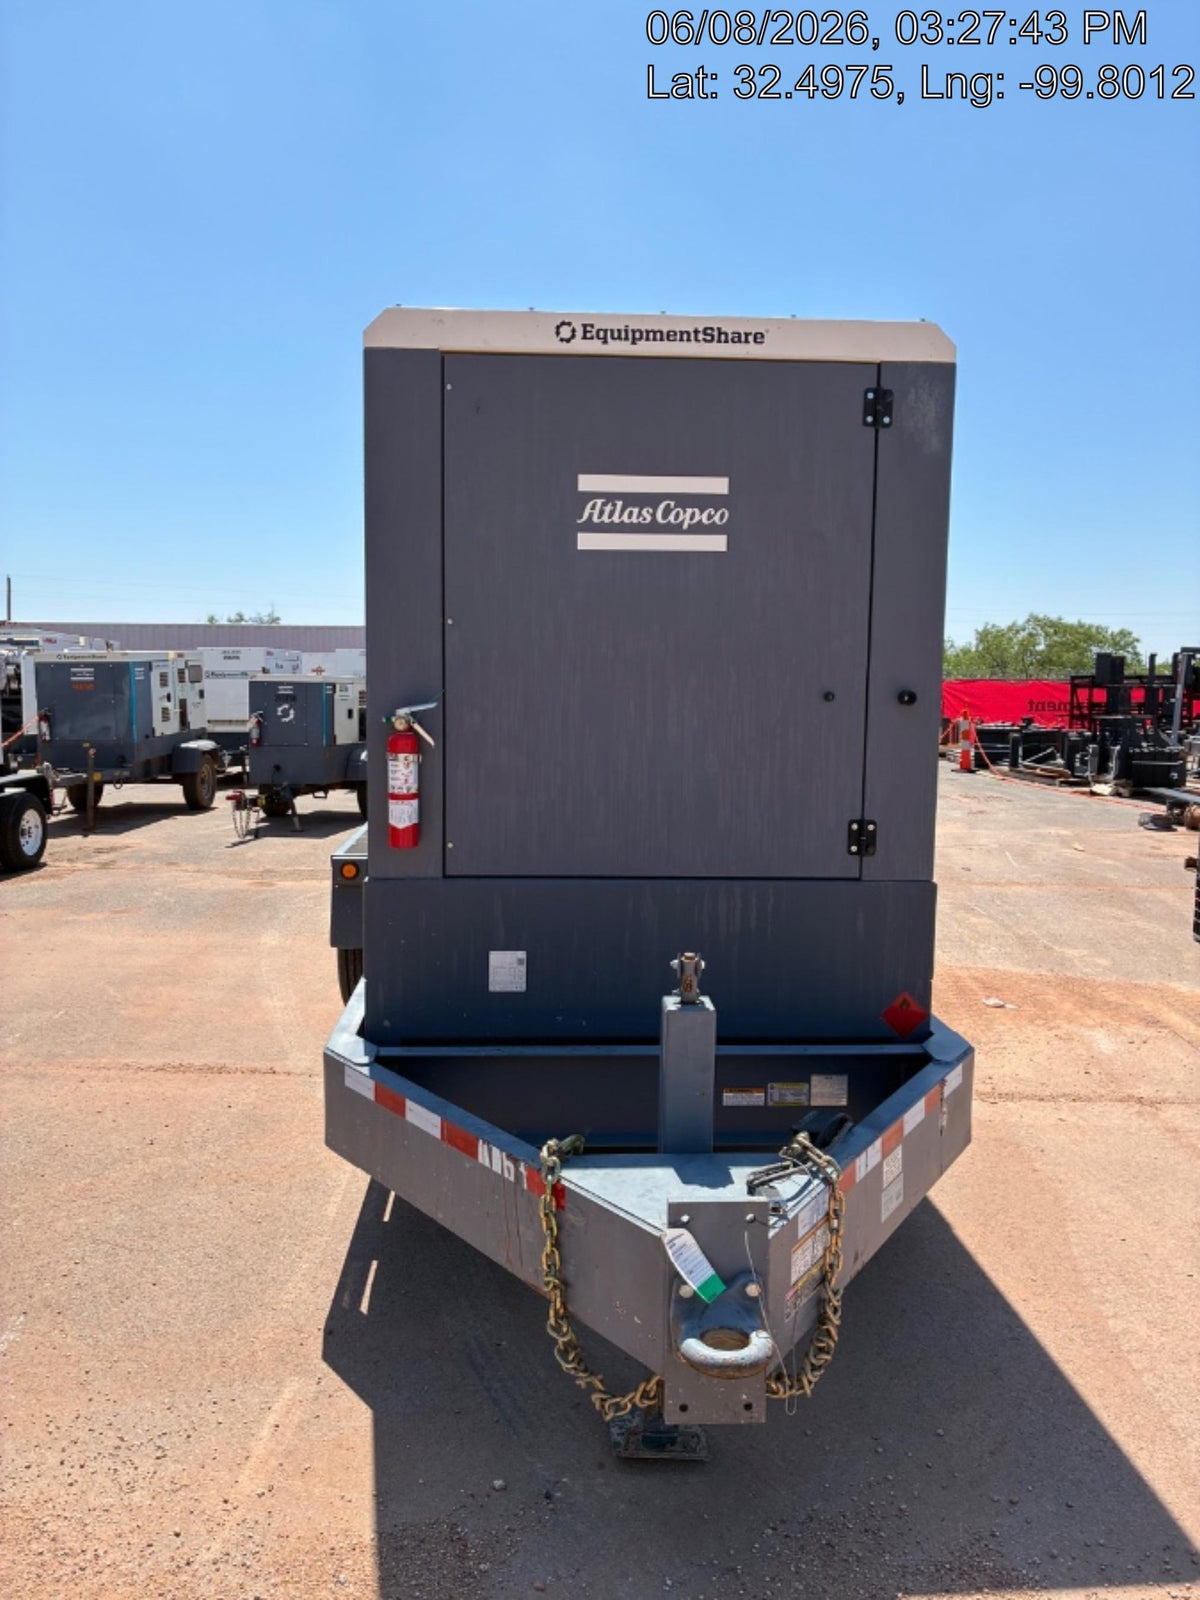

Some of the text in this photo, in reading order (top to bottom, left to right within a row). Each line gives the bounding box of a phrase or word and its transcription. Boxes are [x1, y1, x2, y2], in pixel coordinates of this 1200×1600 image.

[580, 323, 765, 345] EquipmentShare
[576, 498, 730, 530] Atlas Copco
